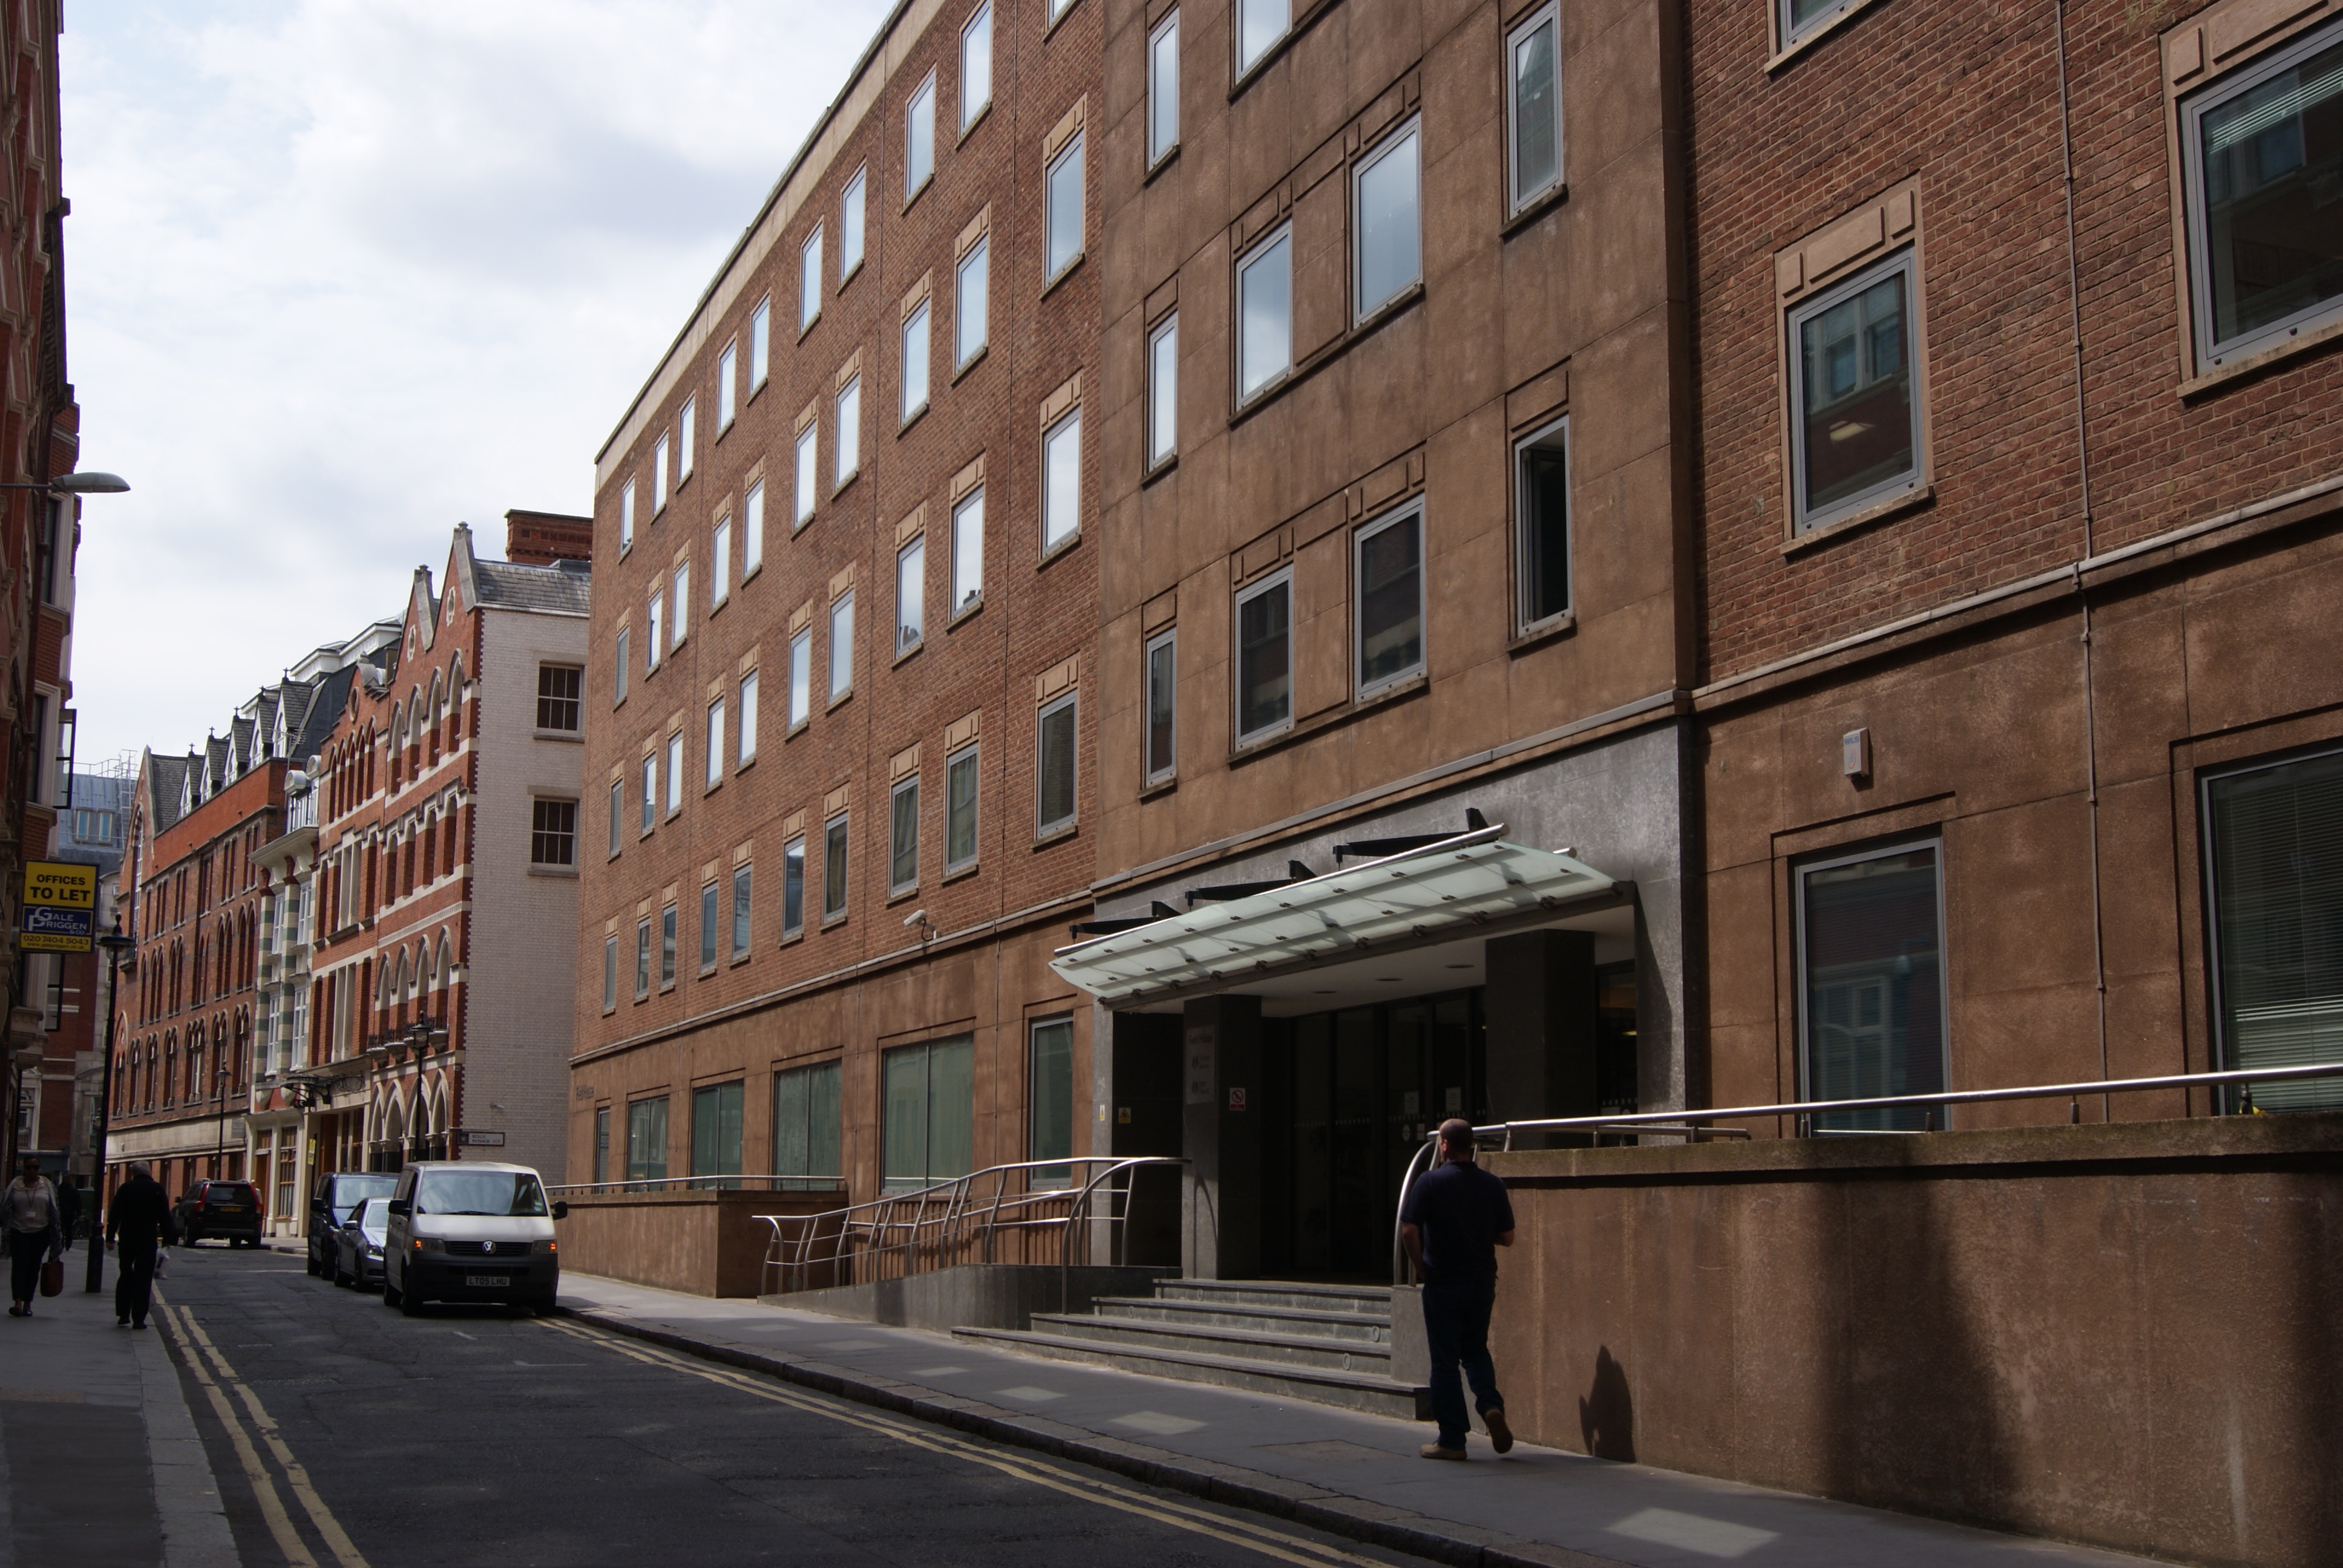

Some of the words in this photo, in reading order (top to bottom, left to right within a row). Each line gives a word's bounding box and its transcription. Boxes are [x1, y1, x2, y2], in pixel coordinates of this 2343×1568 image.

[1844, 736, 1860, 745] WLS
[36, 874, 85, 886] OFFICES
[30, 886, 53, 899] TO
[59, 889, 91, 901] LET
[34, 907, 74, 921] GALE
[28, 915, 87, 932] PRIGGEN
